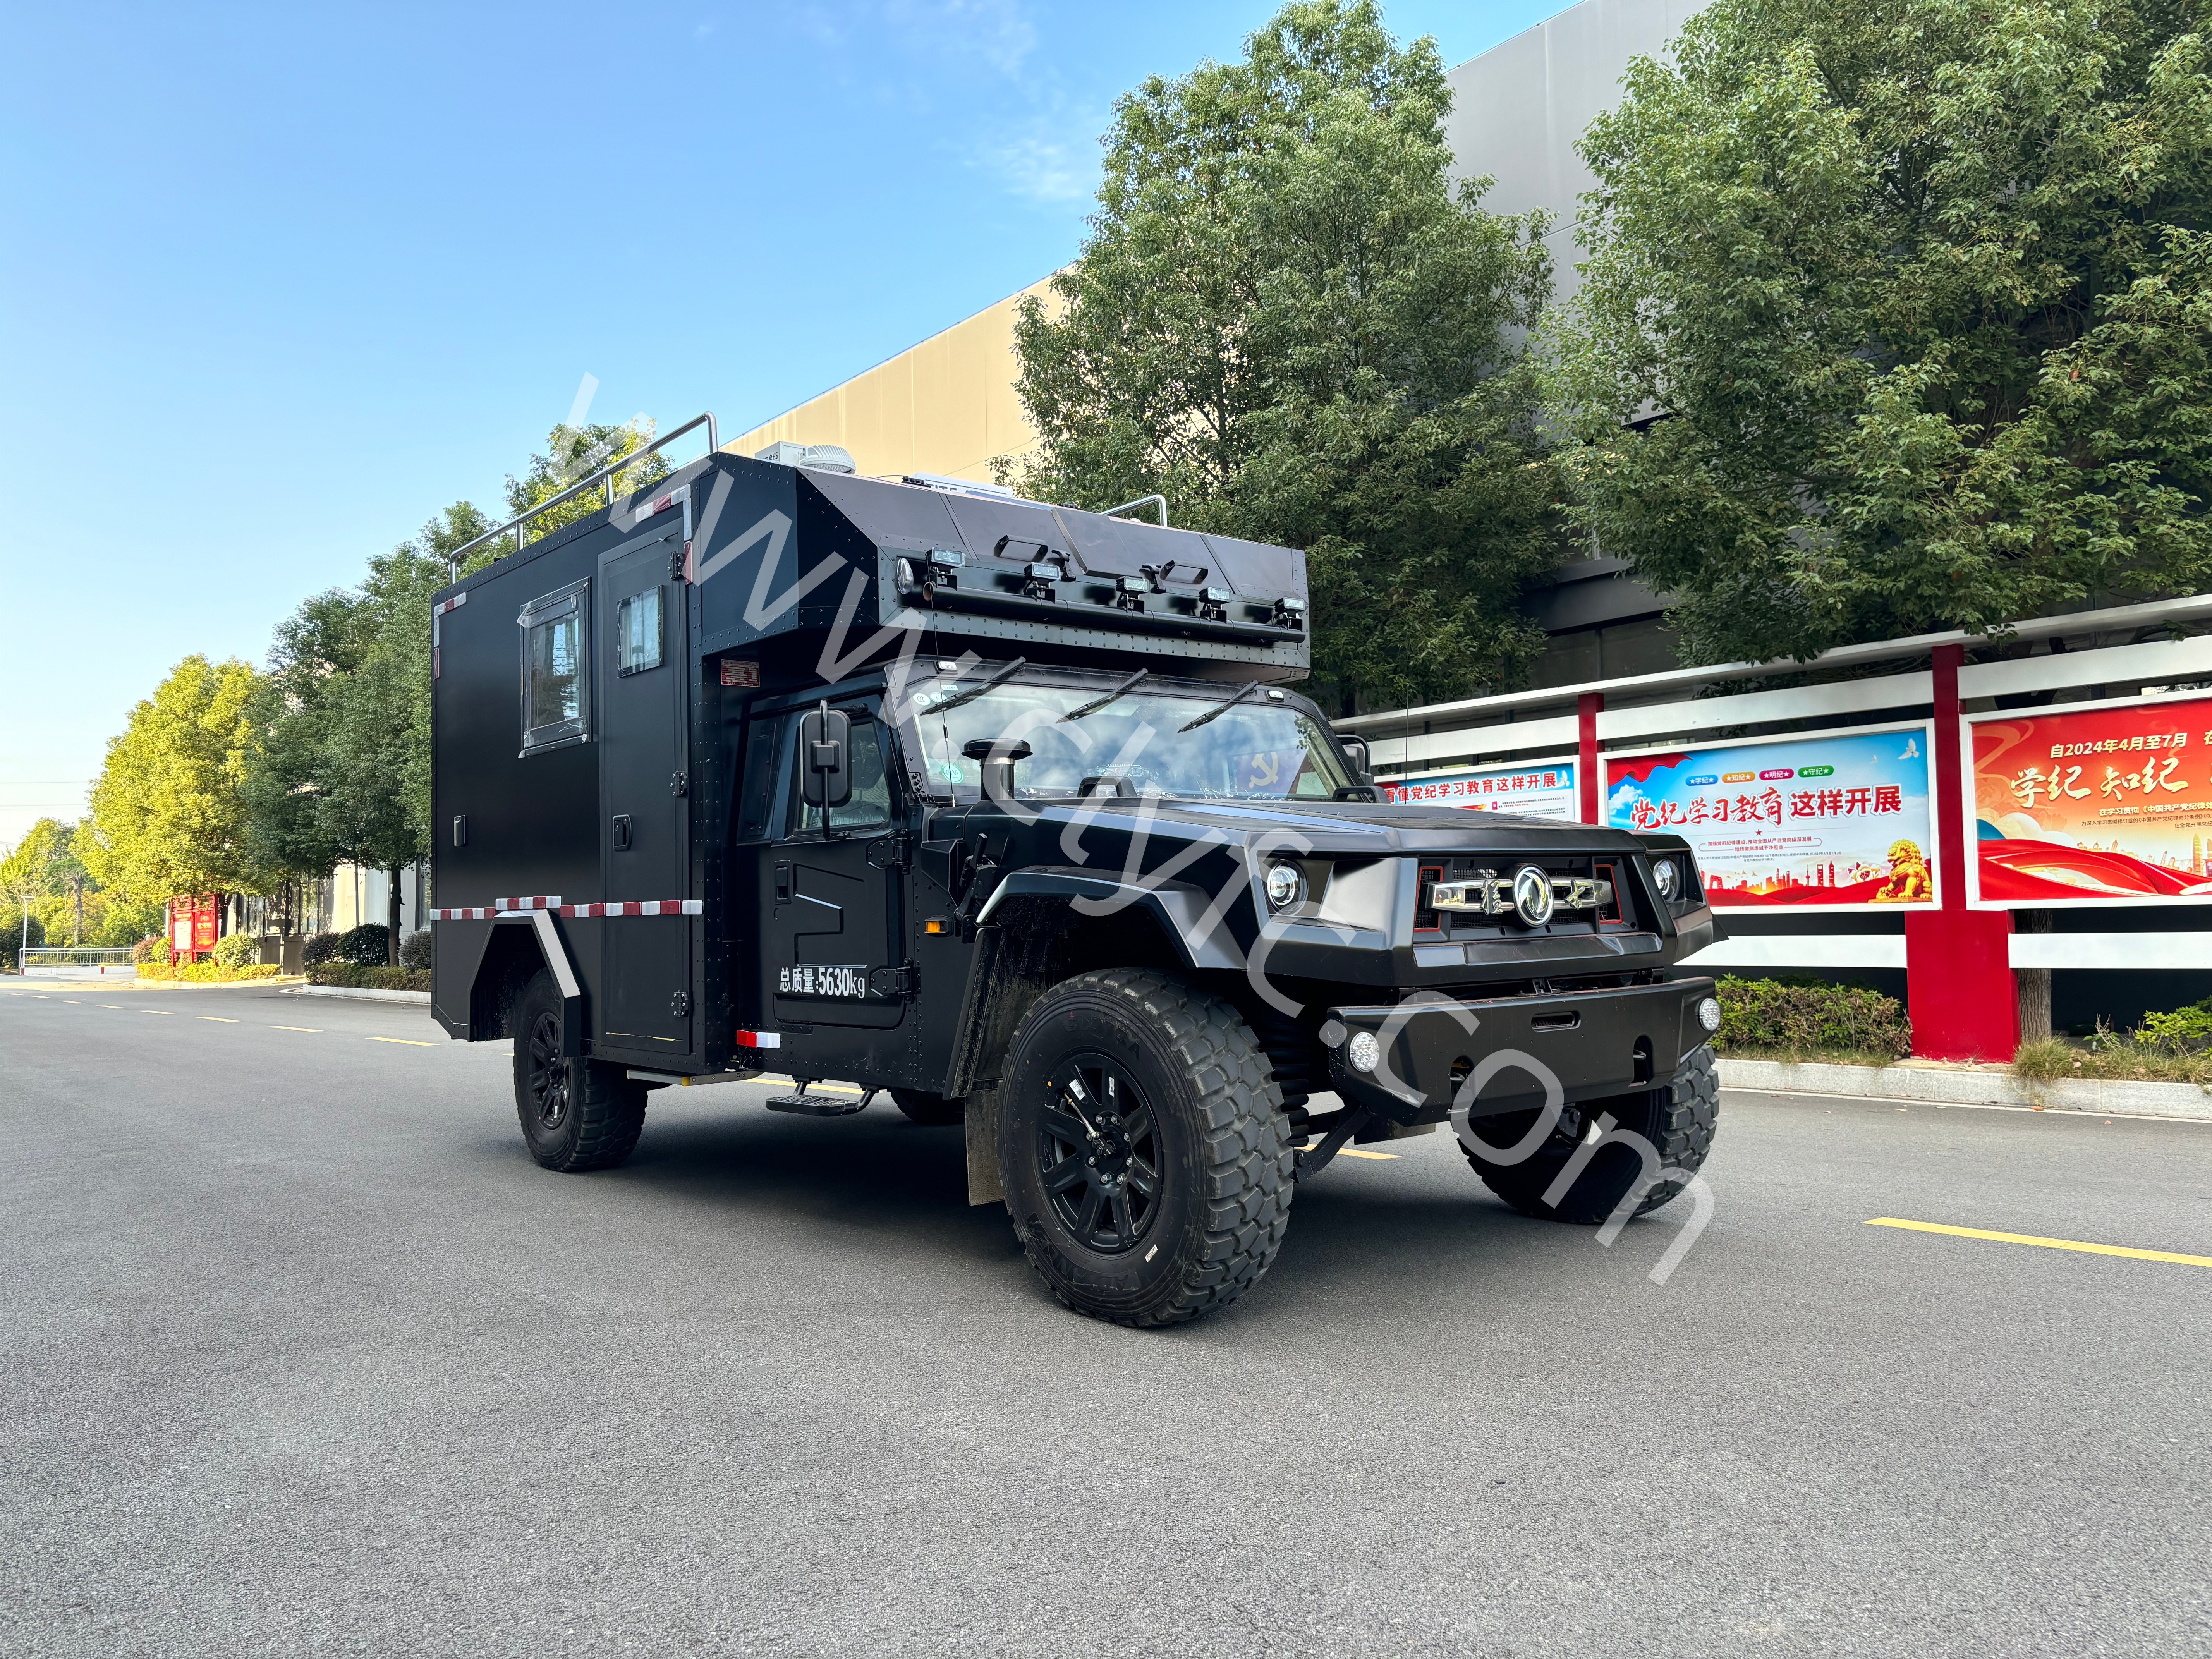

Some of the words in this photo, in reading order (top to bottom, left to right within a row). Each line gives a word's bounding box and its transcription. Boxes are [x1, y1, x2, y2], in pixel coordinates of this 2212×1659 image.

[2050, 733, 2187, 759] 自2024年4月至7月
[1386, 772, 1556, 803] 看懂党纪学习教育这样开展
